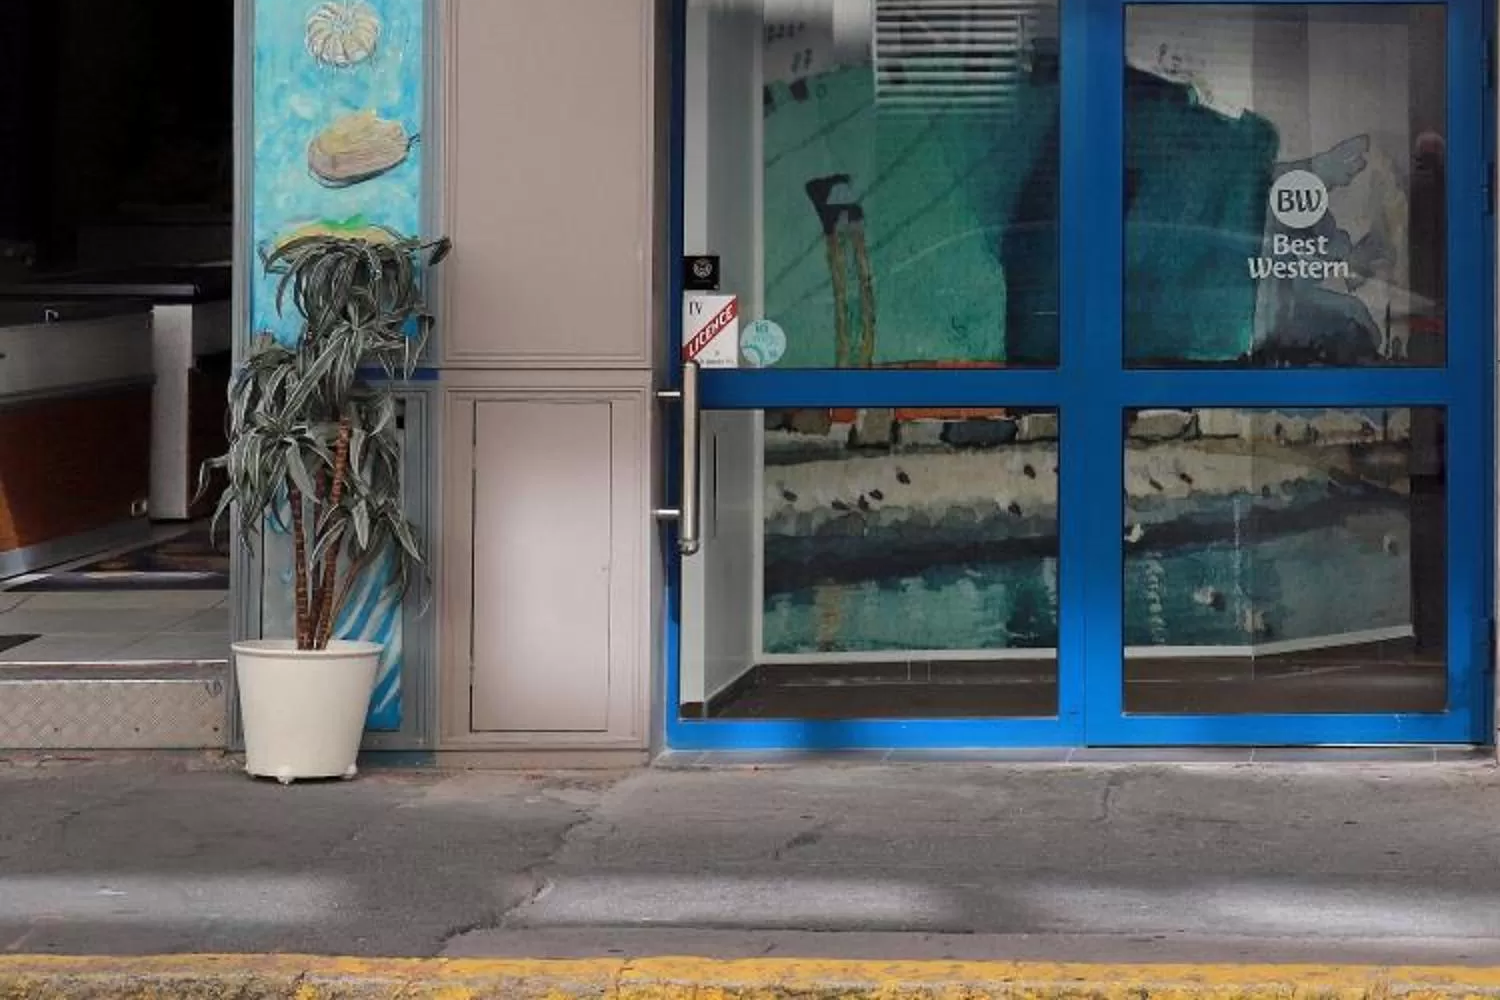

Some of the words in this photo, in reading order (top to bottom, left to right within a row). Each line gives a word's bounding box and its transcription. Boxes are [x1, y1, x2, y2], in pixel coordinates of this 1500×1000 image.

[1278, 189, 1322, 213] BW
[1273, 232, 1328, 255] Best
[1248, 257, 1349, 279] Western
[689, 301, 703, 315] IV
[689, 303, 735, 360] LICENCE
